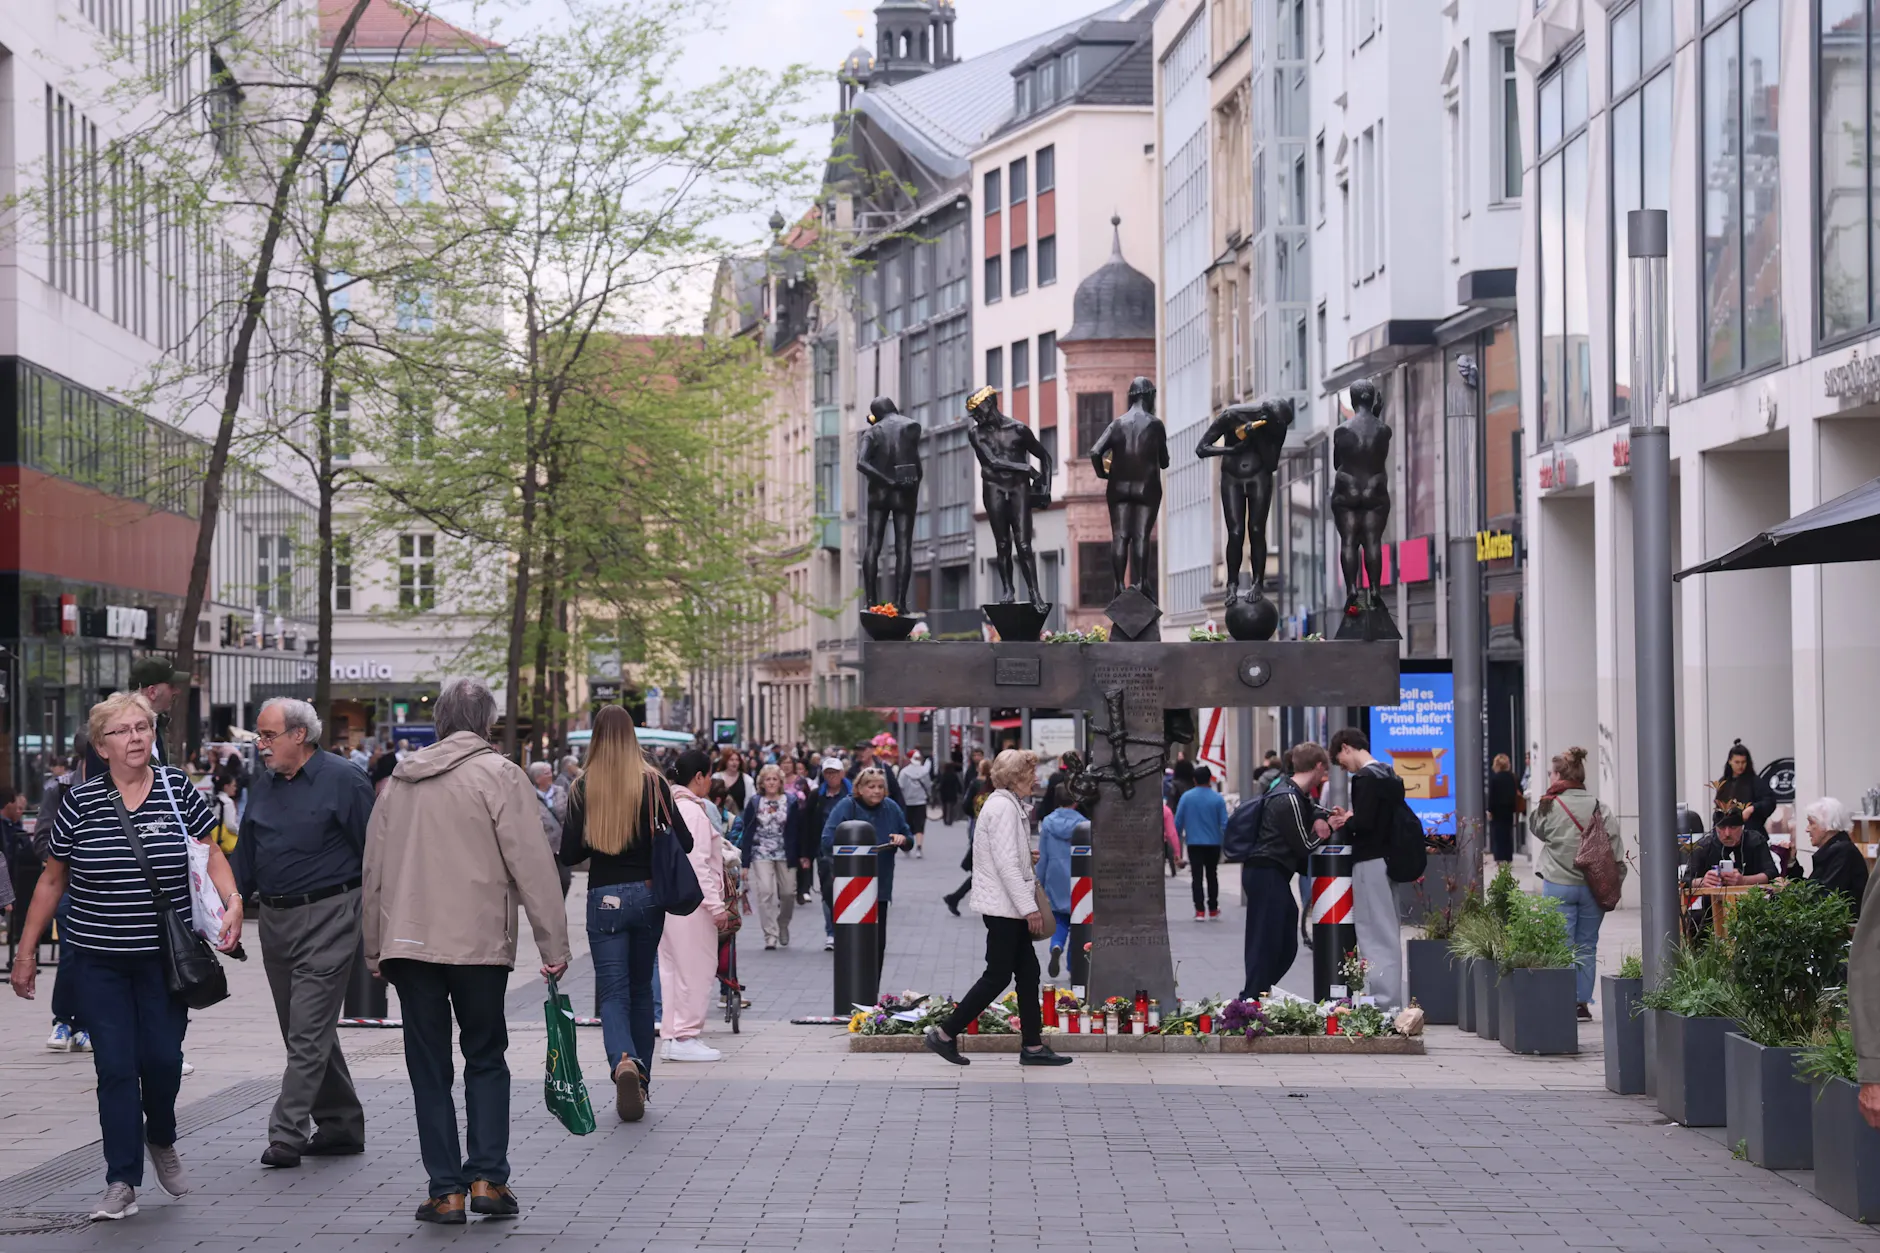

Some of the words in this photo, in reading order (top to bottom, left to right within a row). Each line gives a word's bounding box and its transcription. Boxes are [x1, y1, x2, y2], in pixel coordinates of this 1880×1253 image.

[330, 660, 392, 680] halia
[1400, 688, 1419, 700] Soll
[1420, 690, 1434, 700] es
[1380, 712, 1415, 724] Prime
[1415, 712, 1452, 724] liefert
[1389, 724, 1444, 736] schneller.
